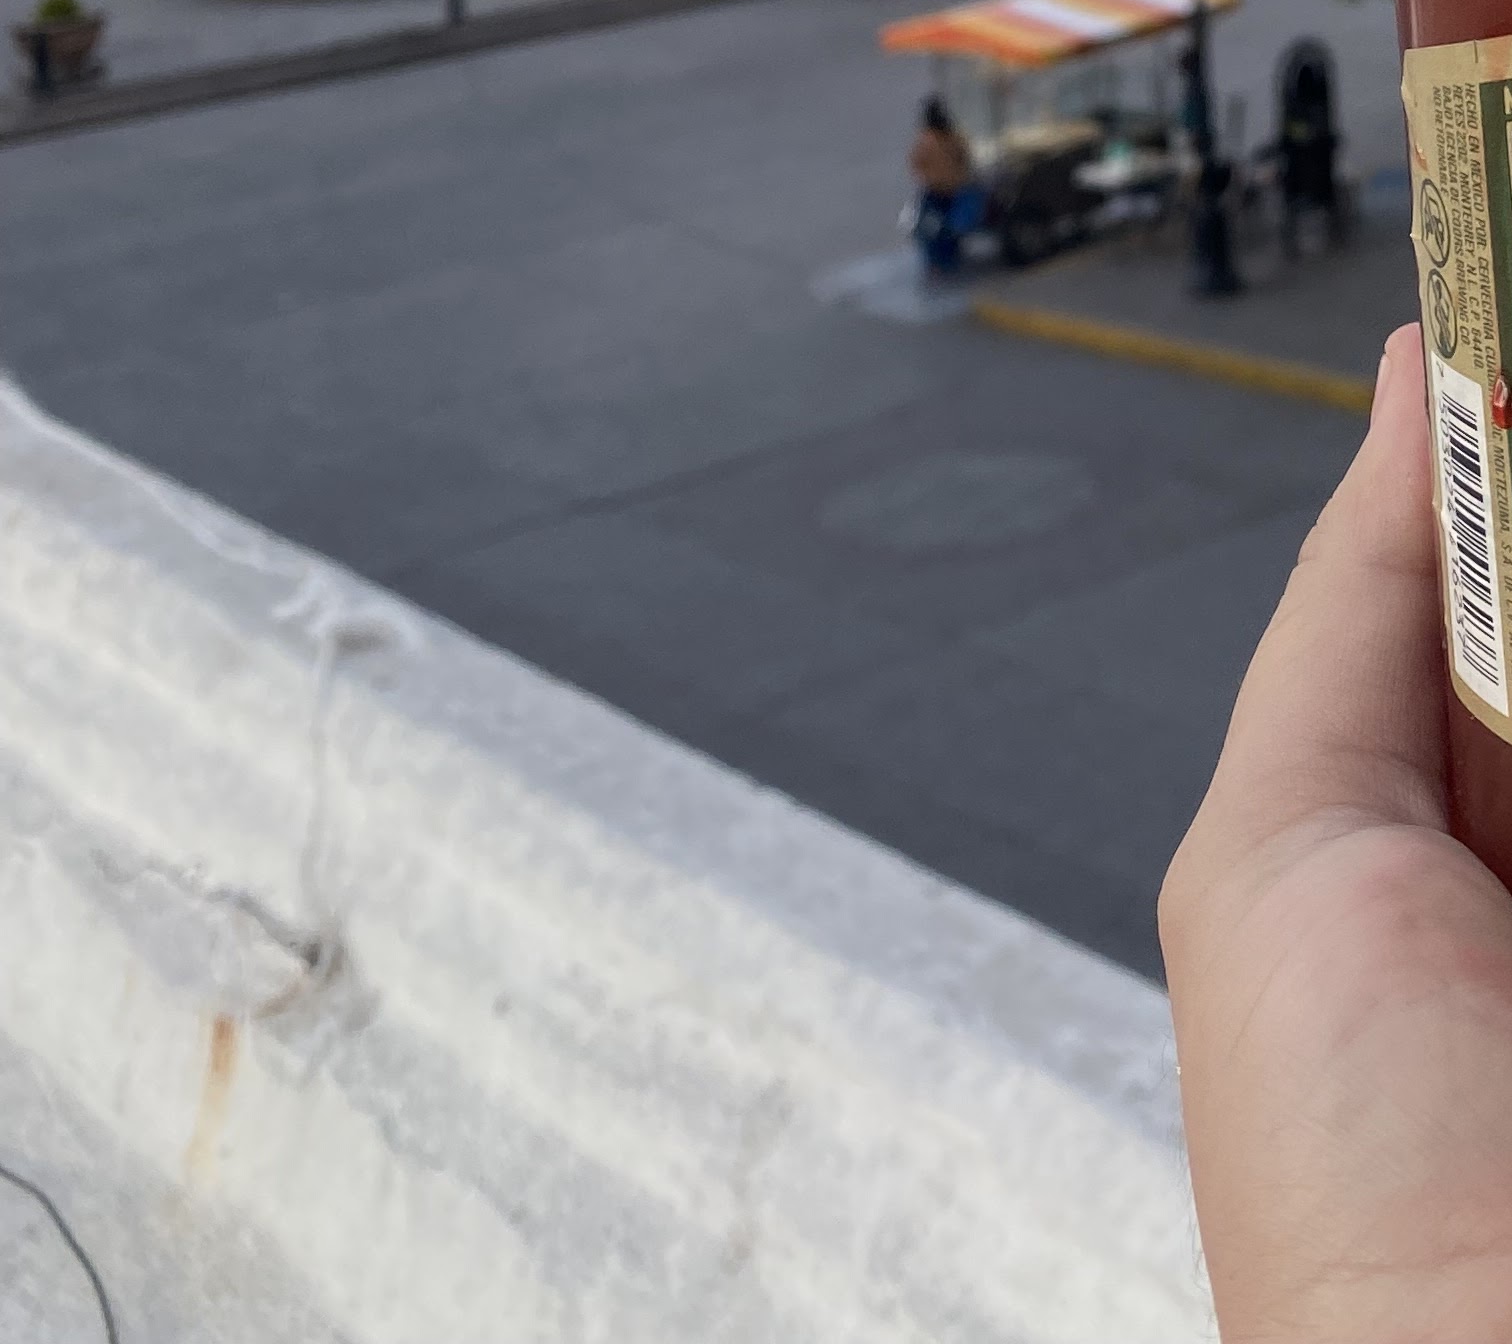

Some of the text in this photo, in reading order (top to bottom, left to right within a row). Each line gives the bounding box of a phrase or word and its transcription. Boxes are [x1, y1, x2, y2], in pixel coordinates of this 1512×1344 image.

[1442, 85, 1454, 120] BAJO
[1453, 83, 1466, 128] REYES
[1465, 82, 1478, 130] HECHO
[1432, 85, 1450, 198] NO RETORNABLE
[1445, 123, 1459, 184] LICENCIA
[1468, 135, 1480, 154] EN
[1450, 186, 1460, 205] DE
[1452, 207, 1464, 256] COORS
[1456, 257, 1470, 324] BREWING
